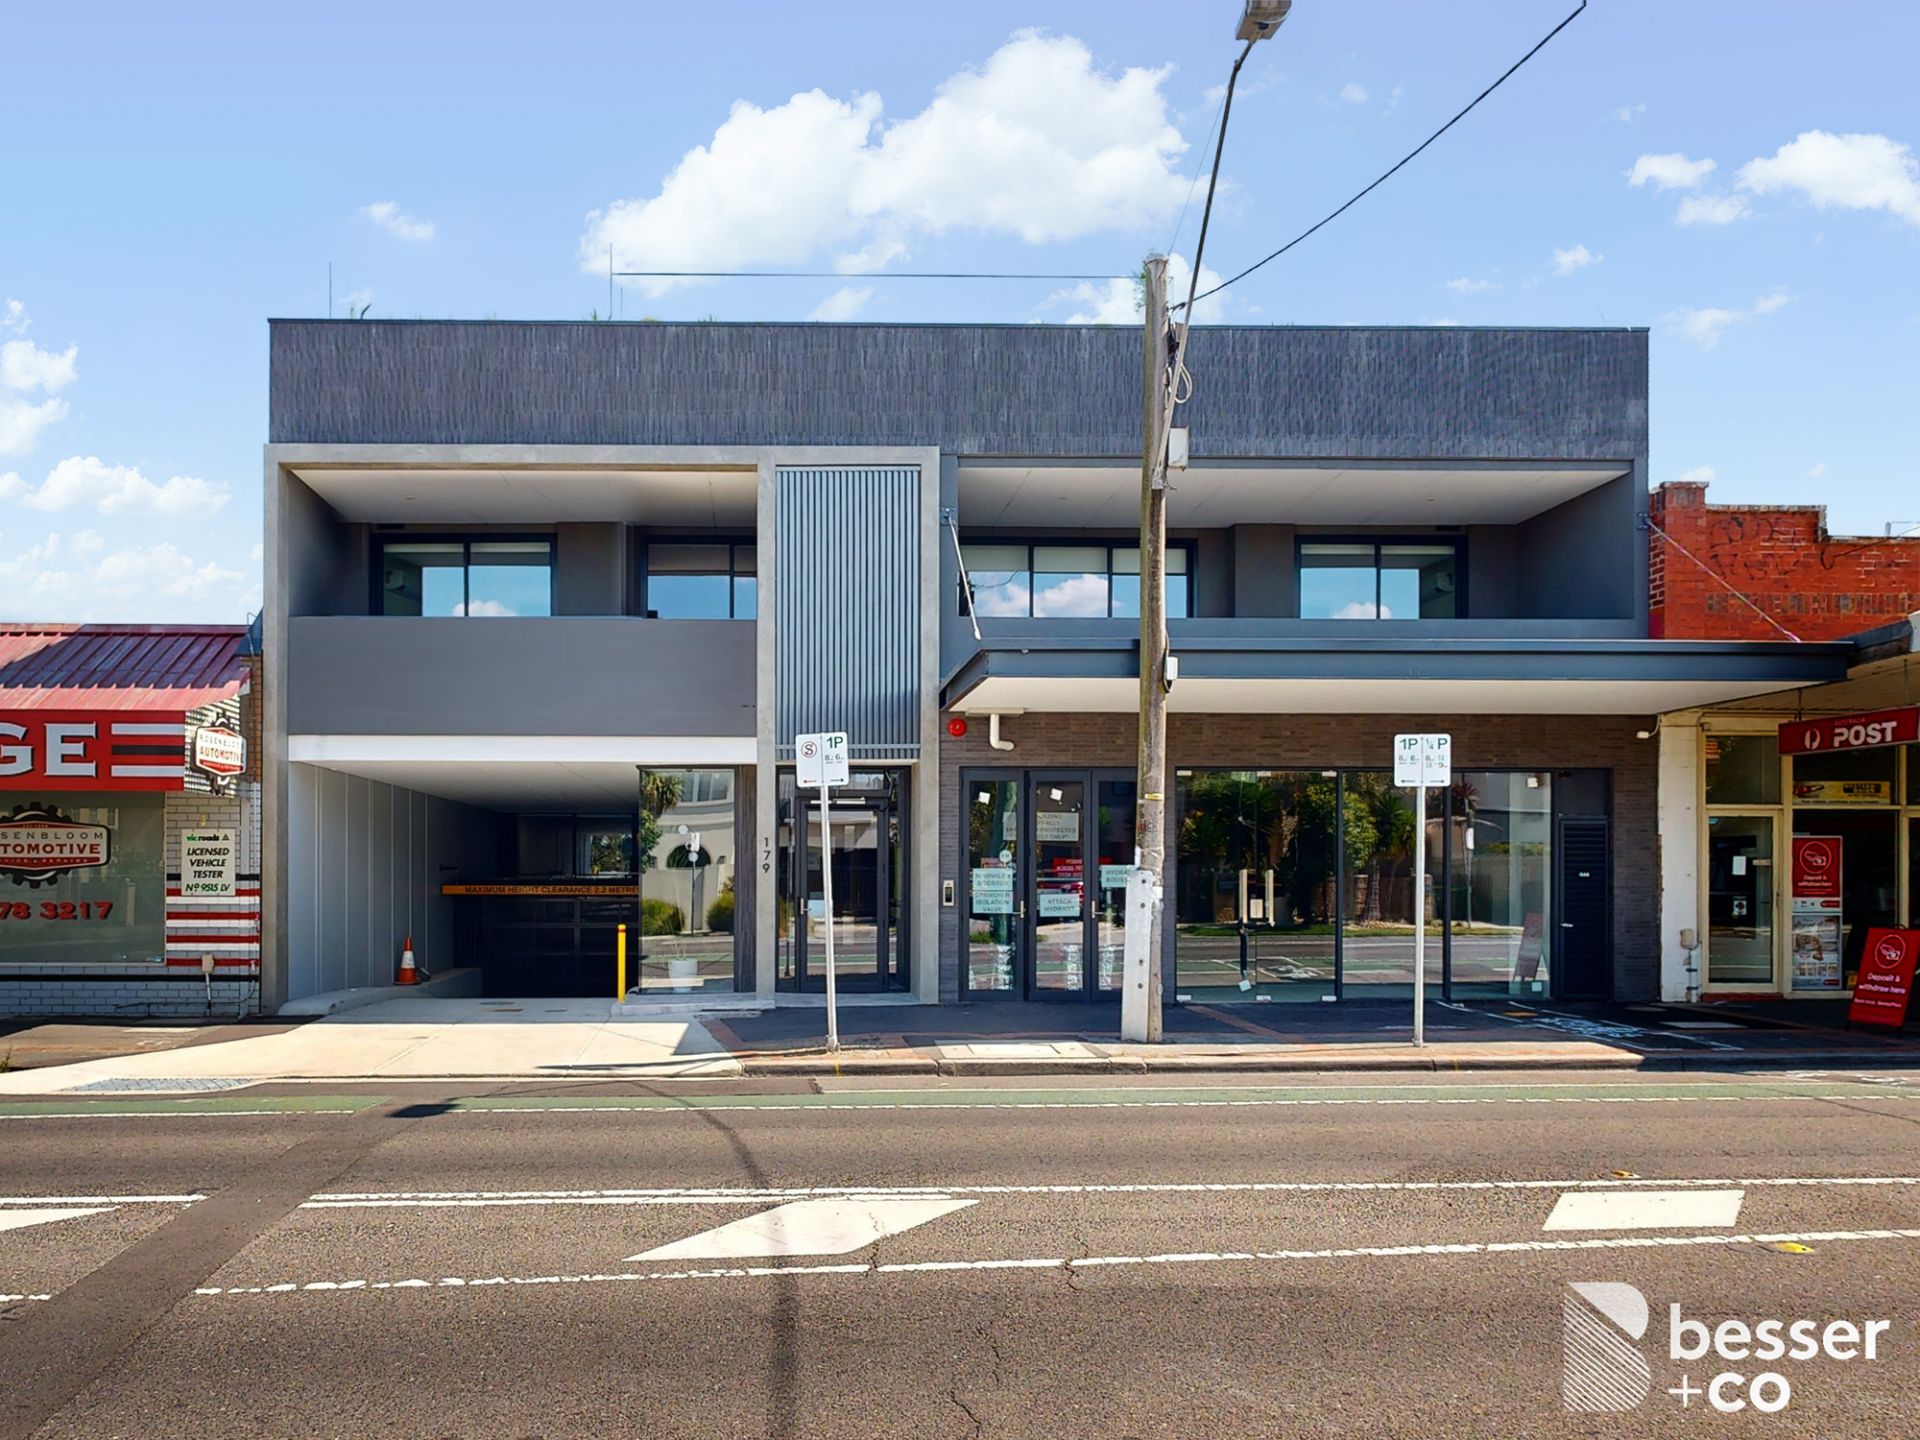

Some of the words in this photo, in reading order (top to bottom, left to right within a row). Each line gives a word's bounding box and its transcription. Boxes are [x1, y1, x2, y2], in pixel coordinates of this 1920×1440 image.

[1833, 721, 1897, 748] POST
[826, 736, 844, 749] 1P
[1399, 738, 1418, 750] 1P
[187, 847, 230, 856] LICENSED
[190, 859, 227, 867] VEHICLE
[193, 870, 224, 878] TESTER
[541, 886, 592, 894] CLEARANCE
[0, 901, 31, 920] 78
[40, 901, 113, 920] 3217
